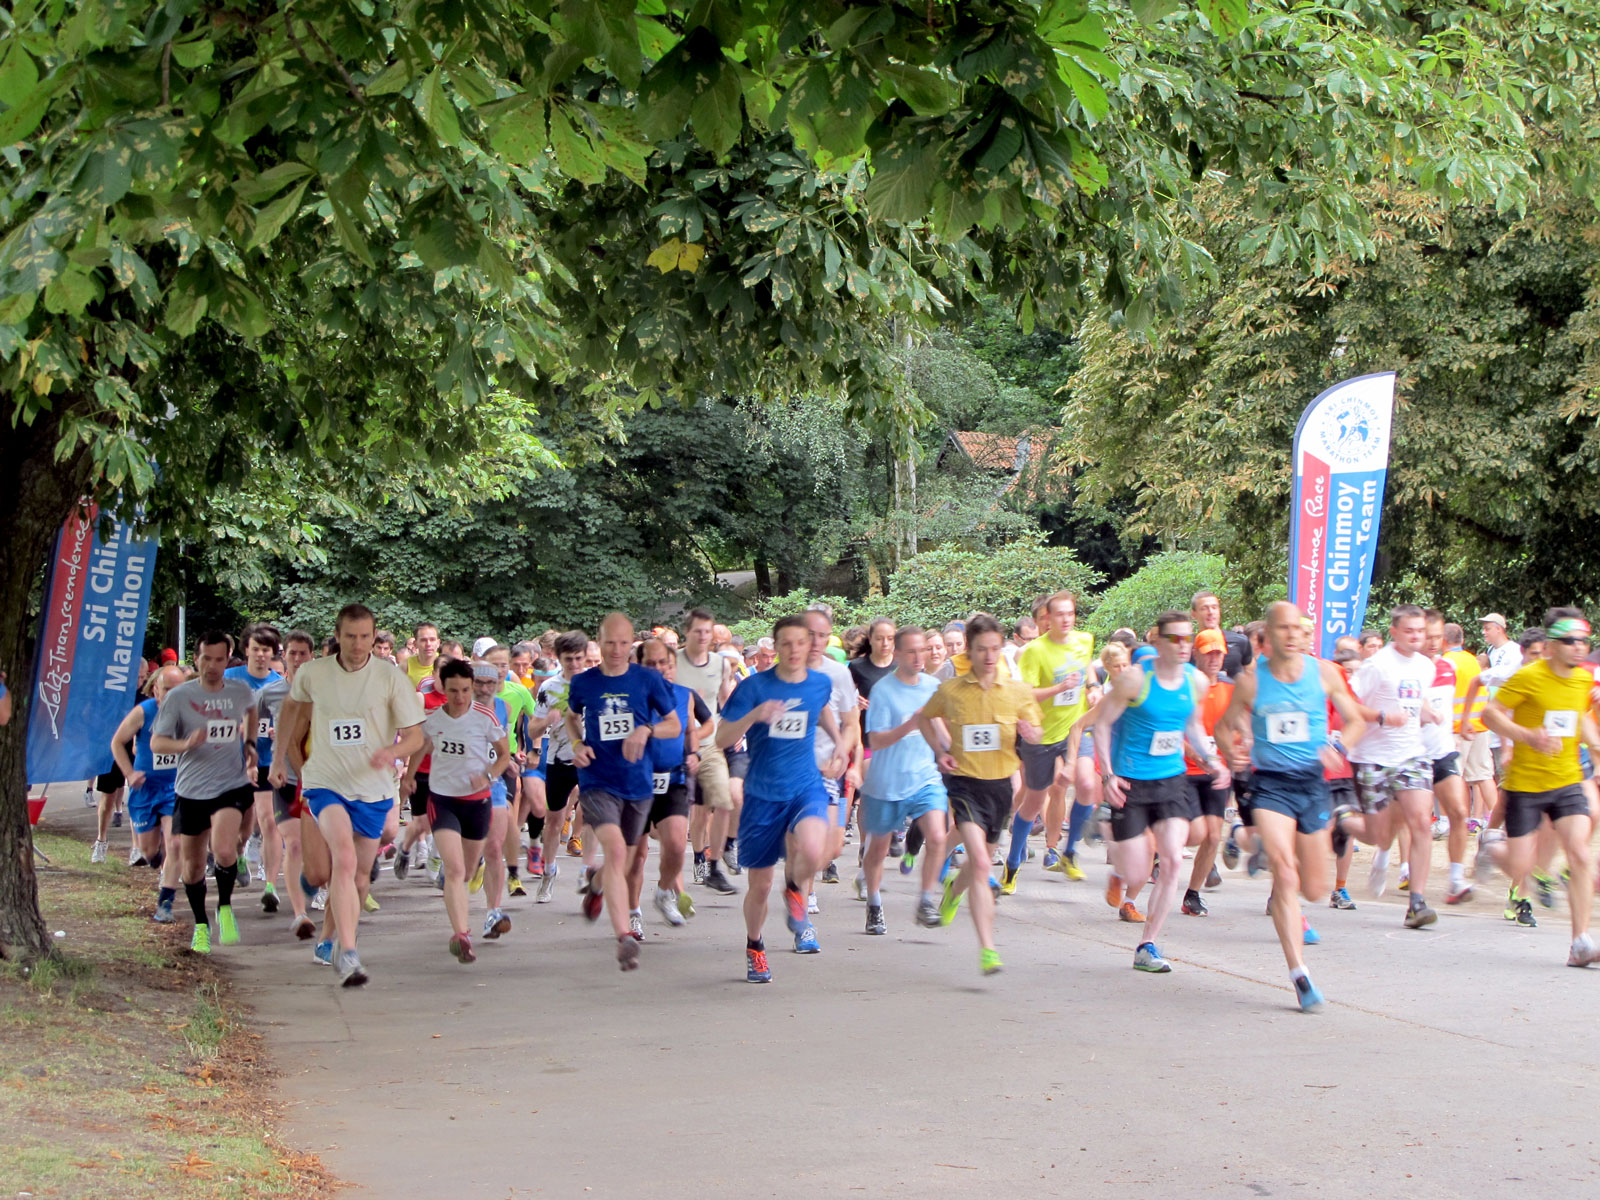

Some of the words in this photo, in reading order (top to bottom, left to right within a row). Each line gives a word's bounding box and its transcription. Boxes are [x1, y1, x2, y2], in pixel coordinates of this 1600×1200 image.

[1304, 475, 1324, 517] Race
[1356, 480, 1377, 546] Team
[1327, 481, 1360, 592] Chinmoy
[39, 518, 90, 740] Self-Transcendence
[83, 603, 109, 642] Sri
[104, 556, 145, 692] Marathon
[1326, 601, 1348, 634] Sri
[210, 726, 234, 738] 817
[333, 724, 362, 740] 133
[604, 720, 630, 735] 253
[156, 755, 176, 765] 262
[441, 741, 465, 755] 233
